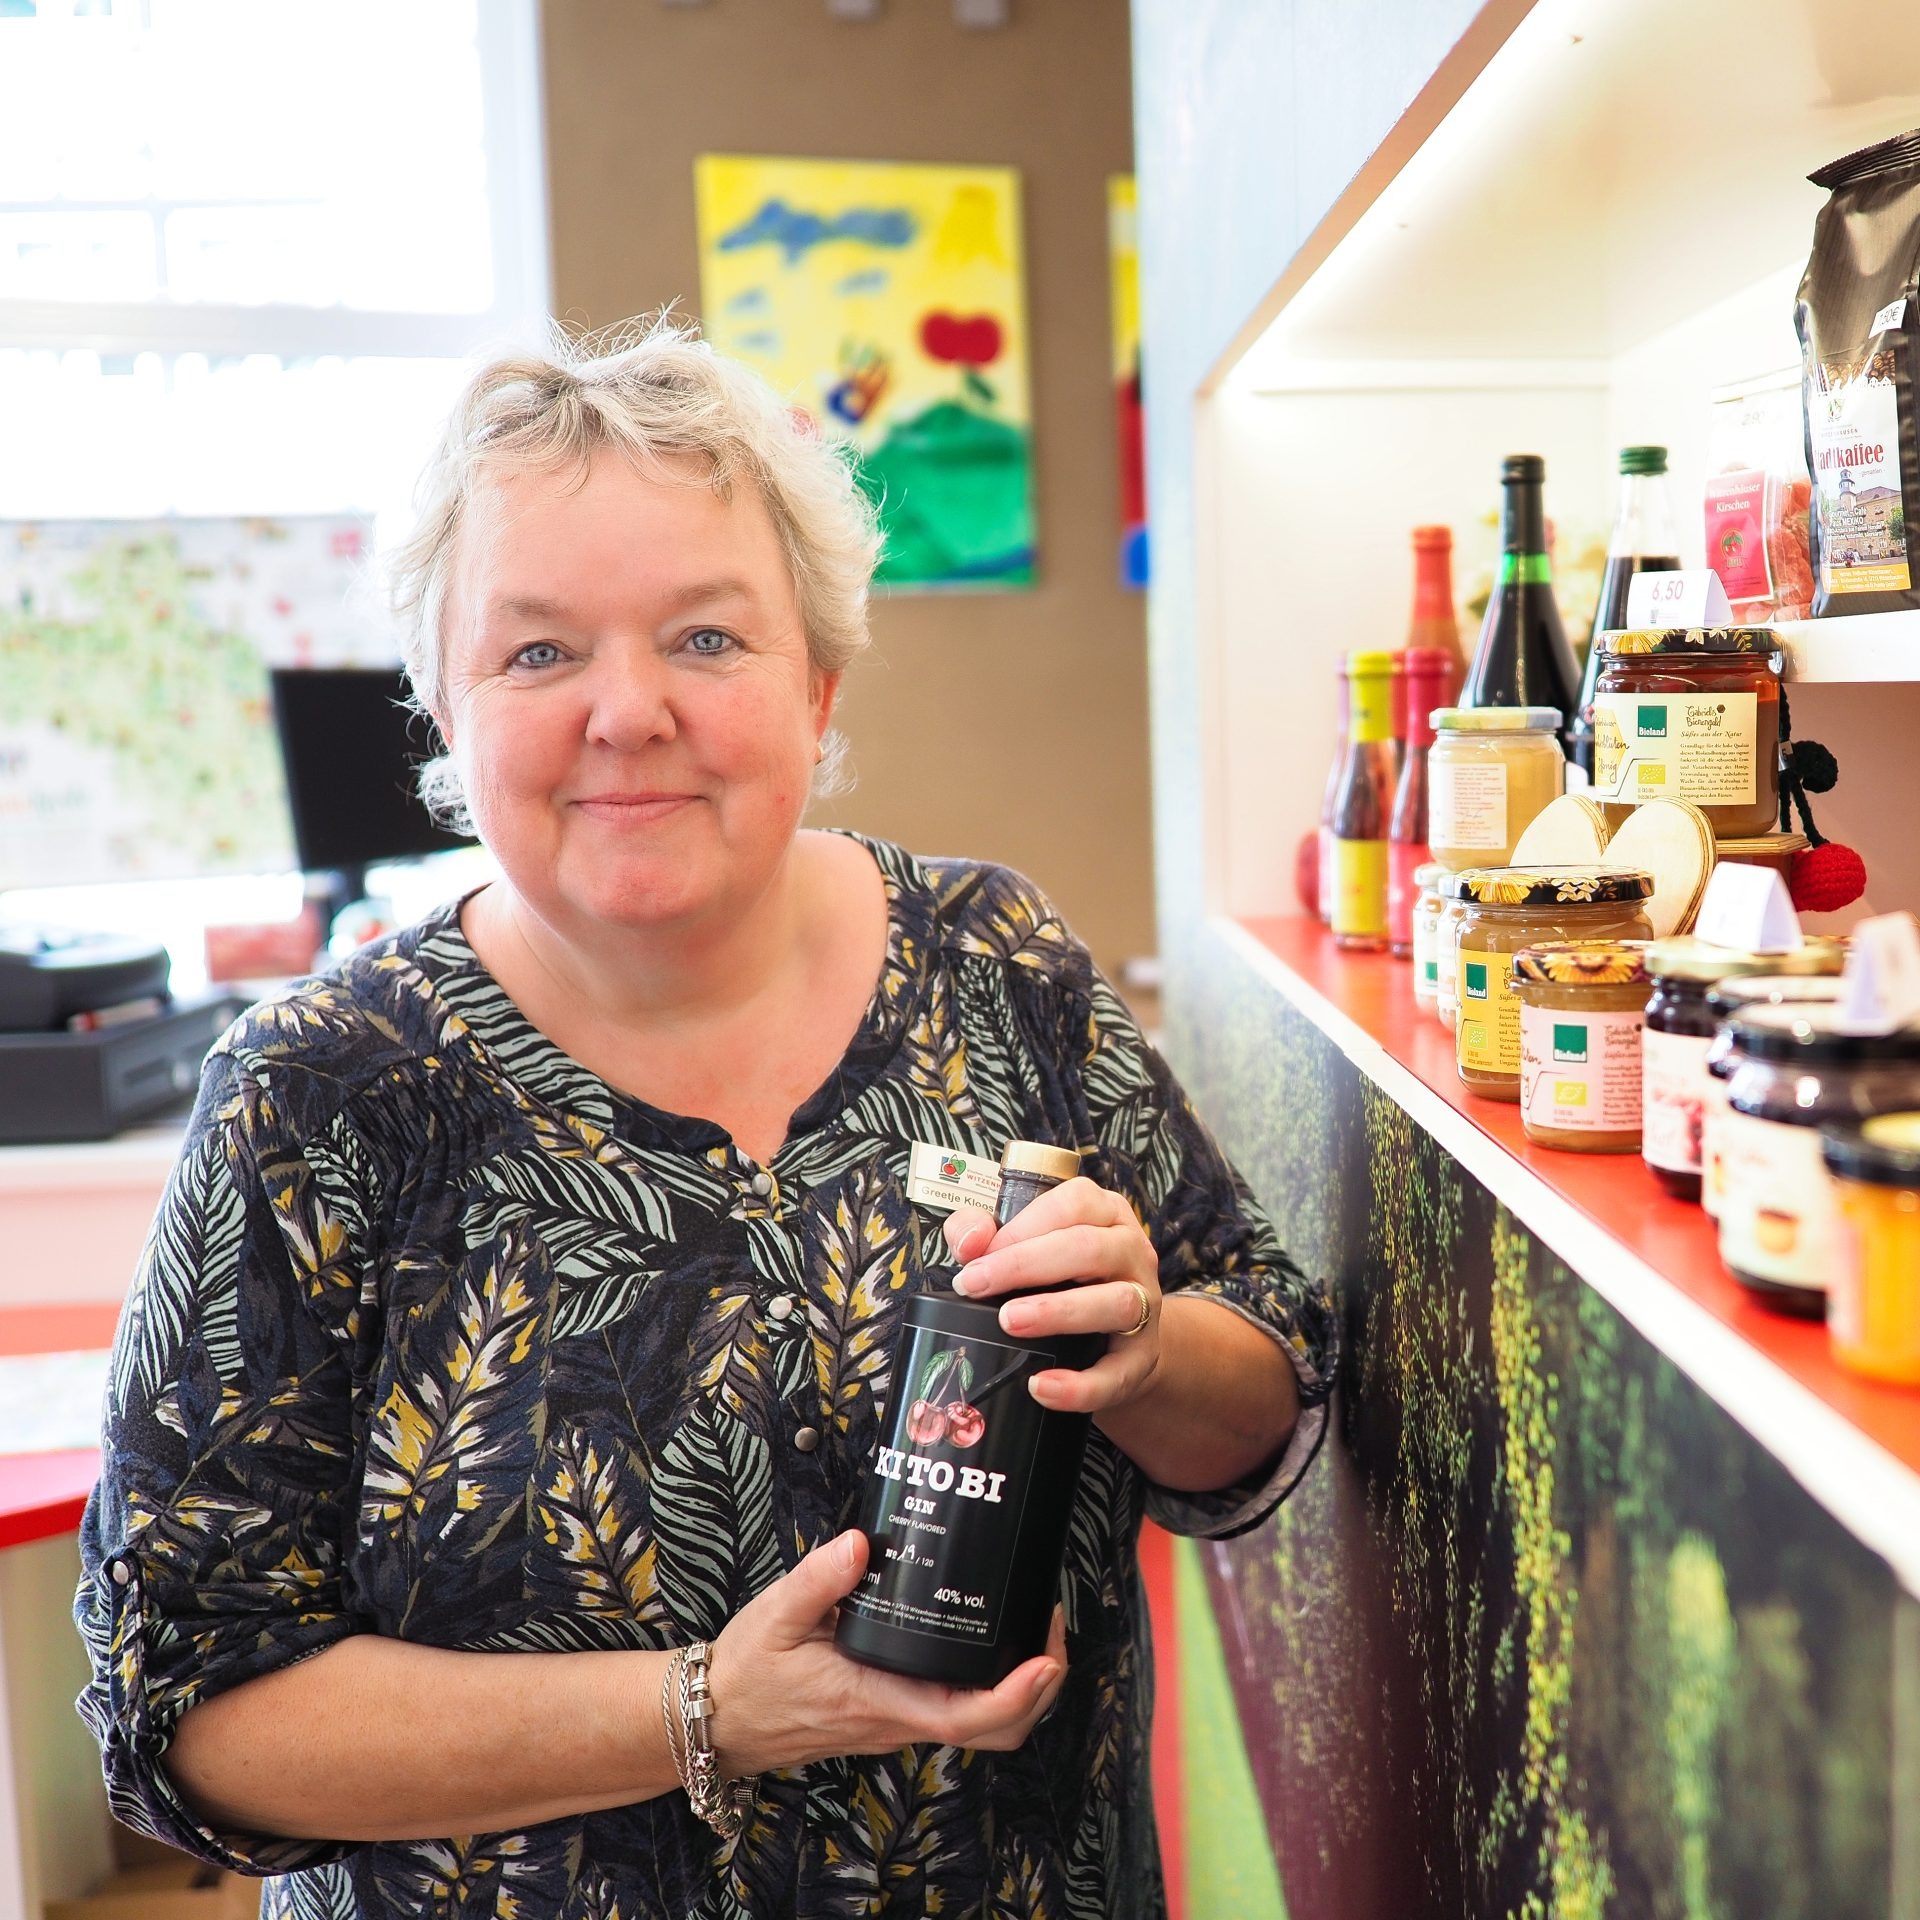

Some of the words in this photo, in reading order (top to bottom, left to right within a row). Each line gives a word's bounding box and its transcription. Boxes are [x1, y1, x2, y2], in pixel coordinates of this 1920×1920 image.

[1715, 500, 1750, 514] Kirschen
[1651, 579, 1684, 601] 6,50
[1638, 726, 1666, 736] Bioland
[1686, 716, 1722, 730] Bienengold
[1680, 731, 1699, 739] Süßes
[1724, 731, 1743, 739] Natur
[1467, 985, 1487, 998] Bioland
[921, 1186, 961, 1203] Greetje
[963, 1196, 994, 1213] Kloos
[874, 1445, 1006, 1503] KITOBI
[904, 1495, 936, 1515] GIN
[888, 1514, 912, 1528] CHERRY
[911, 1521, 947, 1535] FLAVORED
[933, 1587, 961, 1605] 40%
[964, 1595, 986, 1609] vol.
[910, 1606, 942, 1619] Witzenhausen
